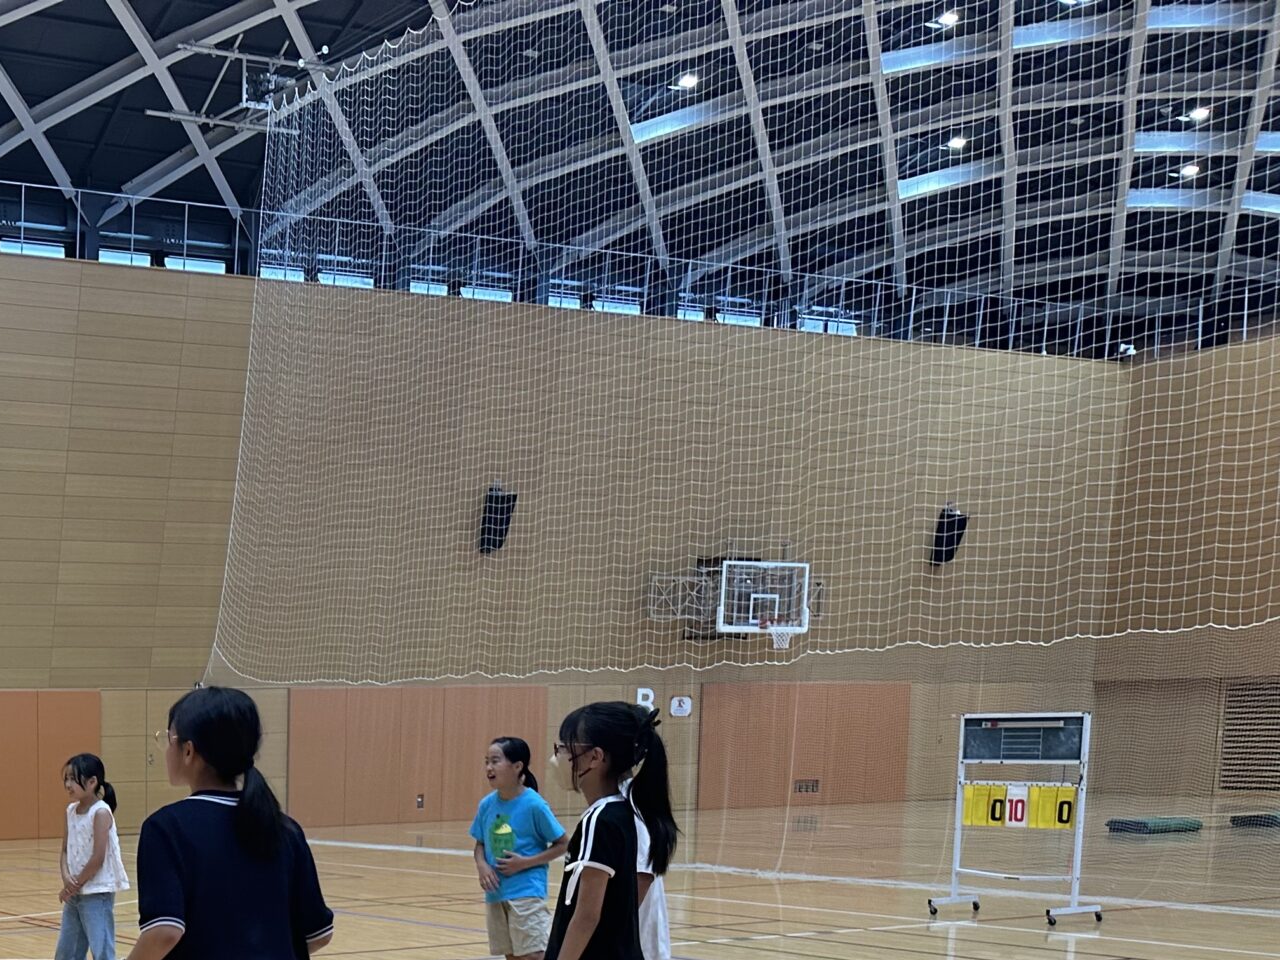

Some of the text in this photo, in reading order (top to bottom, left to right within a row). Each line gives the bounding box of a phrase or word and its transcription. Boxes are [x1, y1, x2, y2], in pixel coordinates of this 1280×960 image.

[990, 798, 1072, 824] 0 10 0
